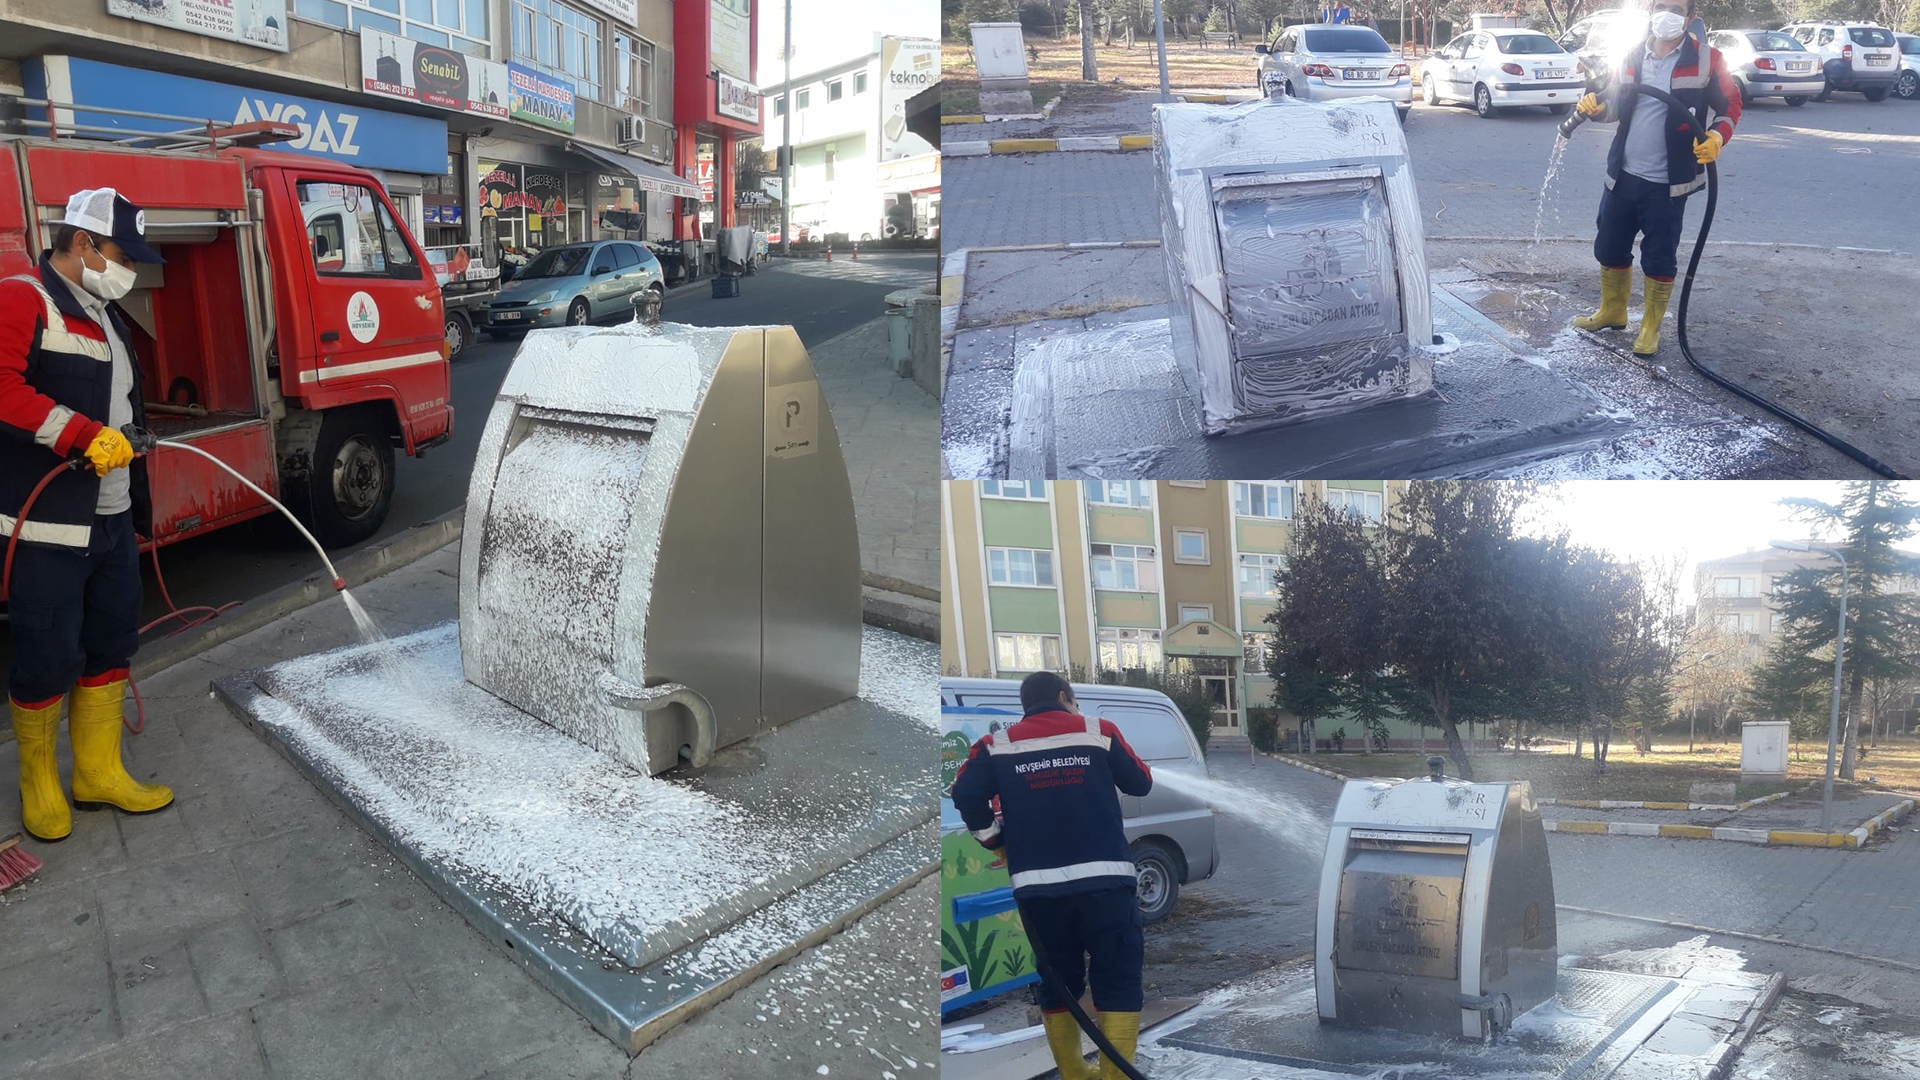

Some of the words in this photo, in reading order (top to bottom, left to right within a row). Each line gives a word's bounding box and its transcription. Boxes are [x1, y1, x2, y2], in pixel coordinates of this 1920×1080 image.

[186, 17, 203, 26] 0384
[204, 21, 217, 30] 212
[522, 93, 563, 123] MANAV
[233, 97, 360, 155] AYGAZ
[502, 191, 542, 214] MANAV
[786, 401, 800, 428] P
[941, 739, 958, 749] miz
[1015, 758, 1051, 774] NEVŞEHİR
[1052, 754, 1091, 768] BELEDİYESİ
